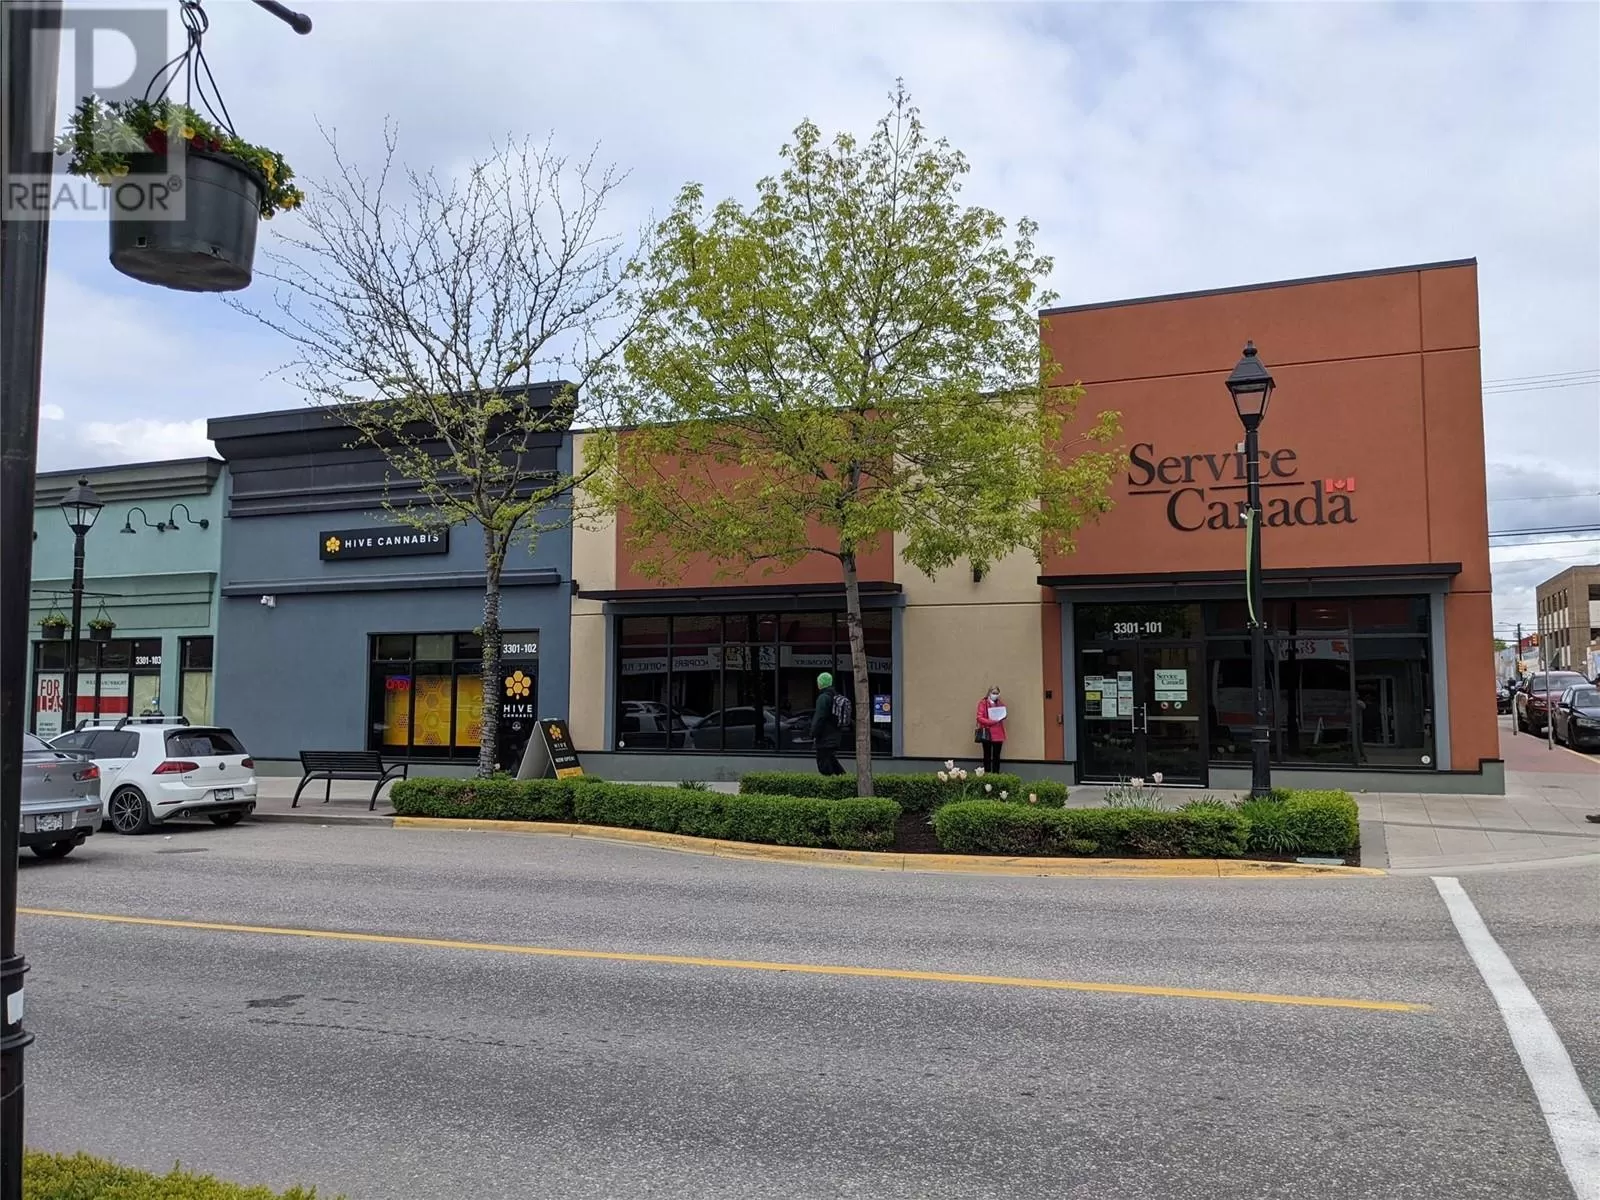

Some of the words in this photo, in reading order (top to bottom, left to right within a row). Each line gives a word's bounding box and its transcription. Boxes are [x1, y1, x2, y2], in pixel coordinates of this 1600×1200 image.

[1128, 442, 1298, 487] Service
[344, 538, 373, 549] HIVE
[377, 534, 440, 546] CANNABIS
[1113, 621, 1163, 634] 3301-101
[502, 643, 537, 654] 3301-102
[135, 656, 162, 665] 3301-103
[40, 679, 60, 696] FOR
[503, 704, 533, 713] HIVE
